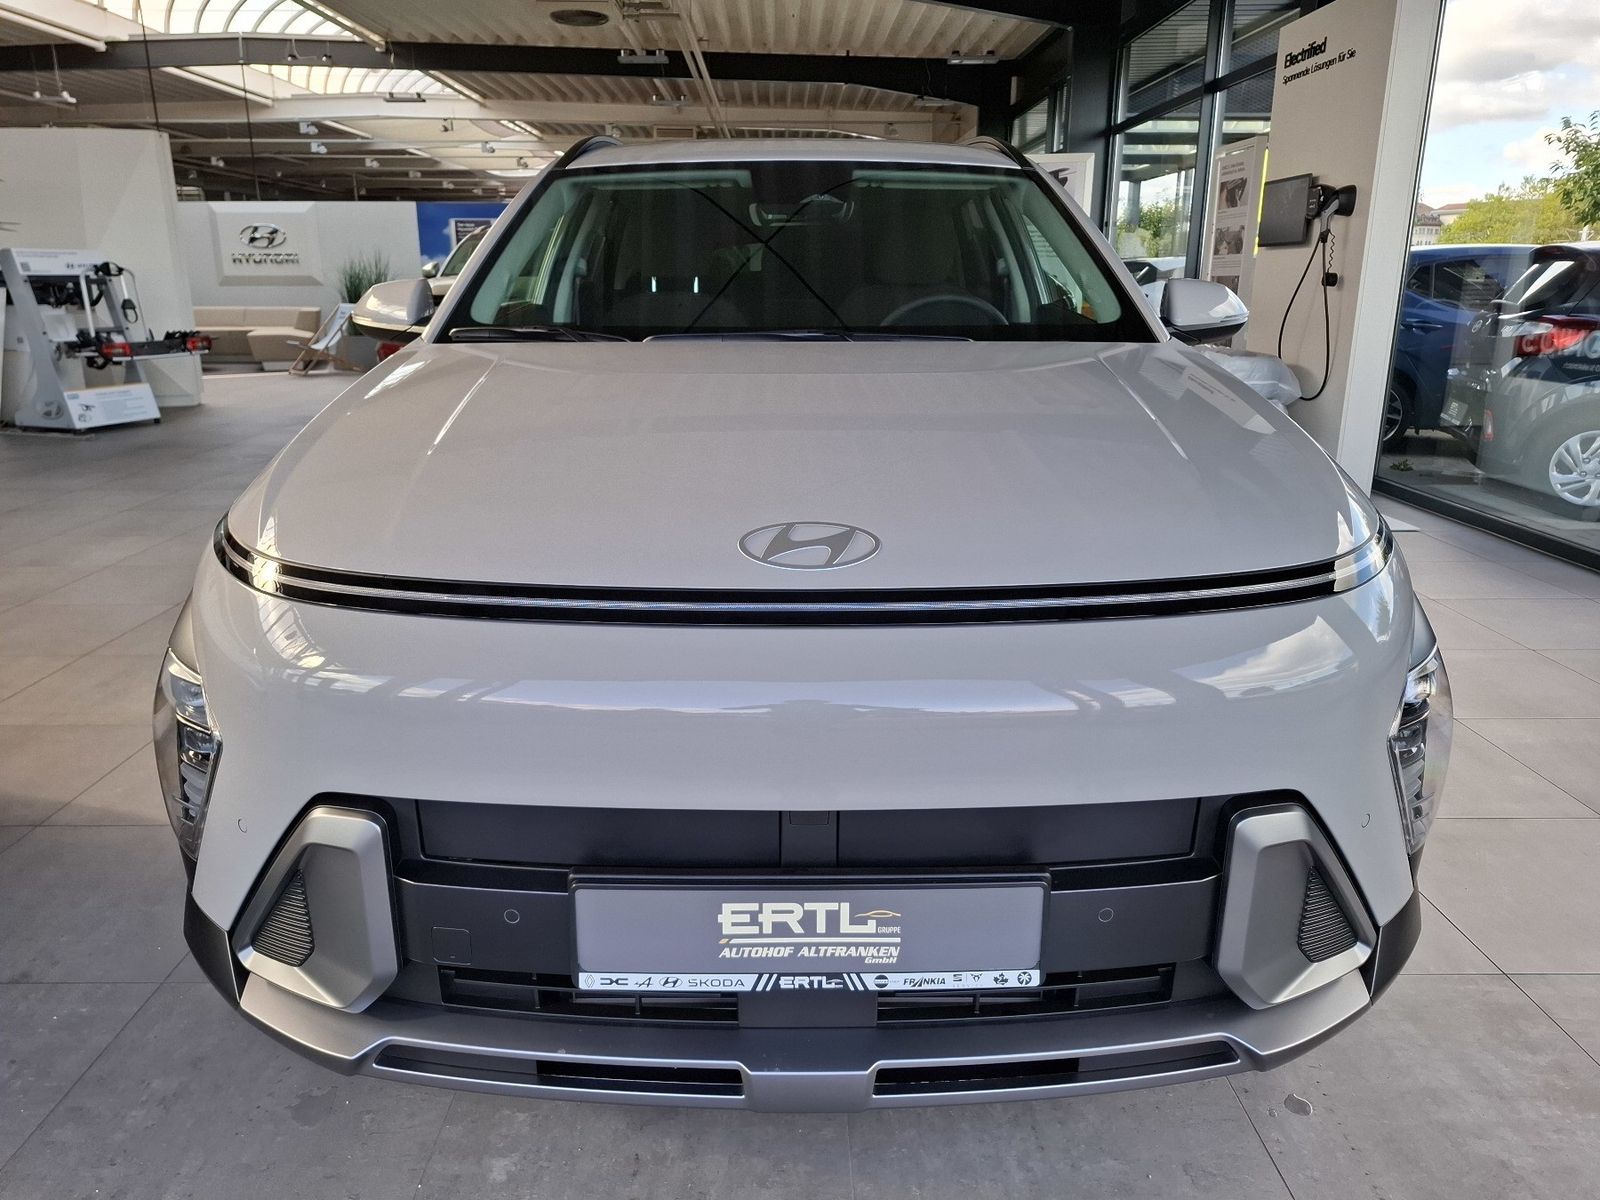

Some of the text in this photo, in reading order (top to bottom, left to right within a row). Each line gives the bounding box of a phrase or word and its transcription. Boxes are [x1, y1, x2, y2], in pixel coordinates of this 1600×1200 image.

[1284, 36, 1327, 69] Electrified
[1282, 48, 1356, 85] Spannende Lösungen für Sie
[231, 252, 299, 265] HYUNDAI
[717, 902, 876, 934] ERTL
[877, 926, 901, 934] GRUPPE
[719, 946, 900, 958] AUTOHOF ALTFRANKEN
[779, 976, 836, 989] ERTL
[903, 977, 946, 987] FRANKIA
